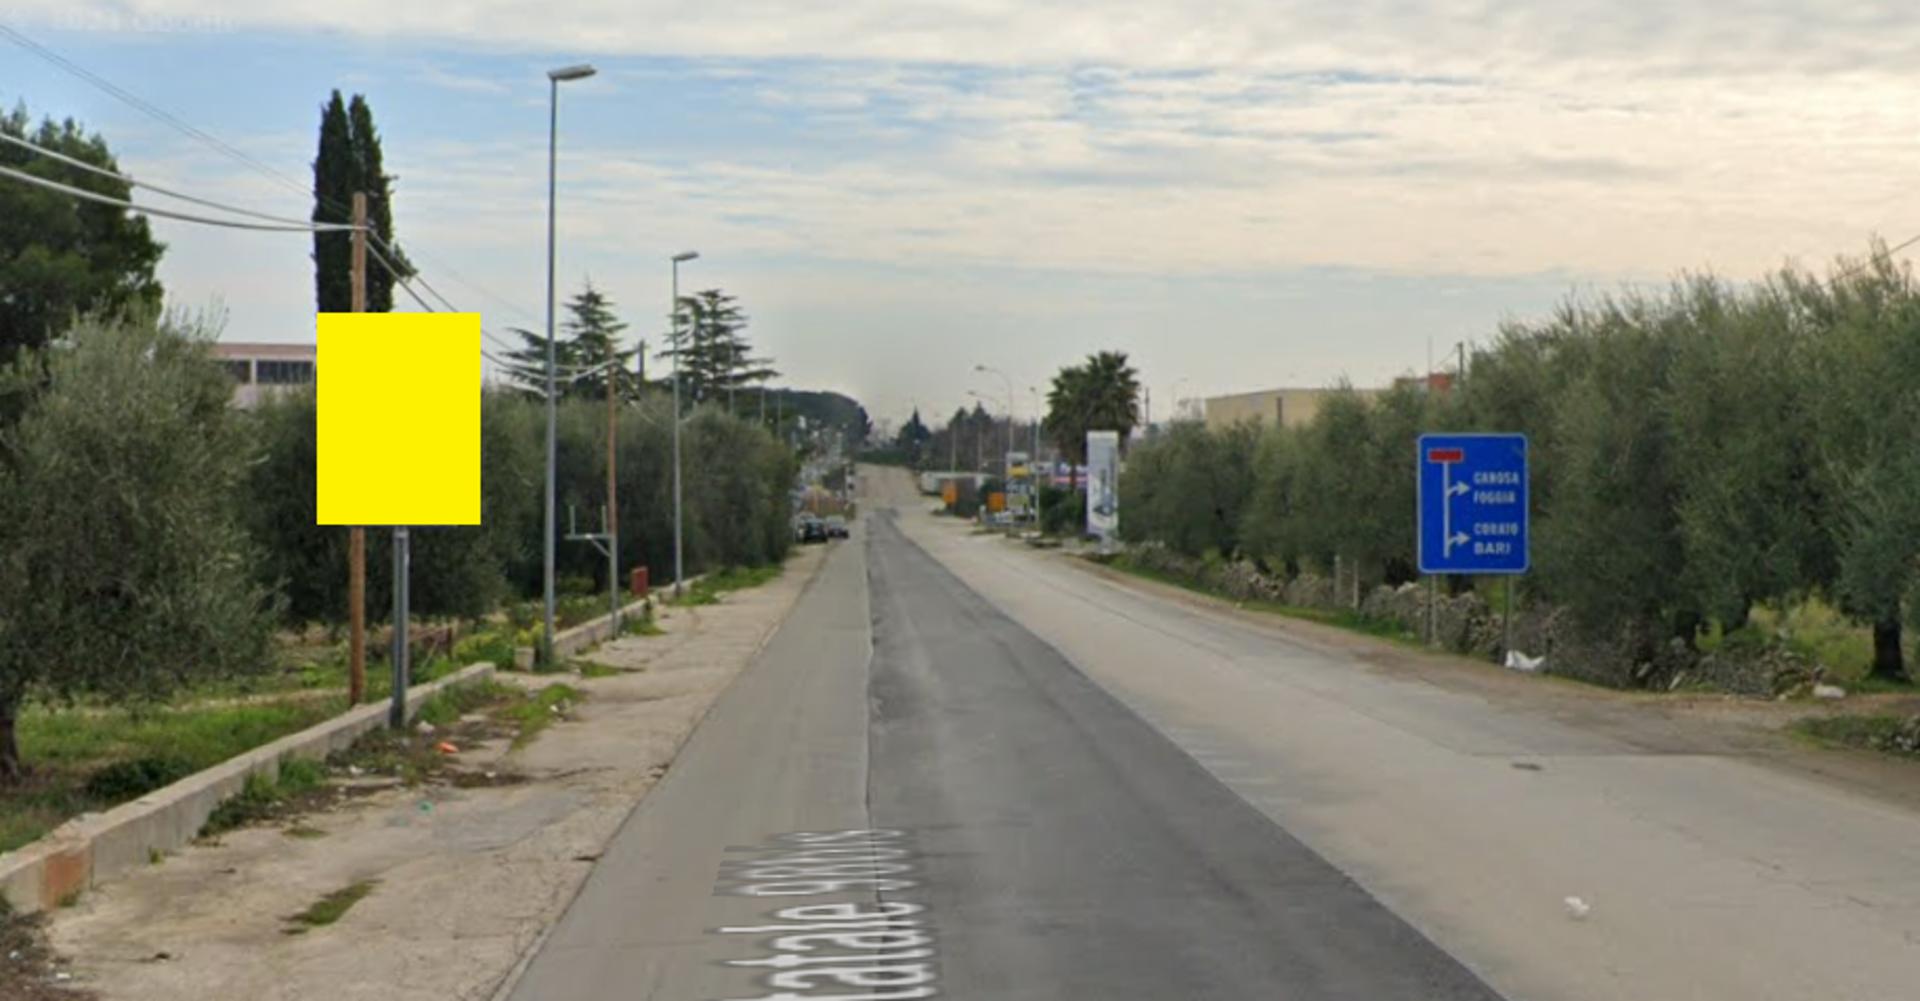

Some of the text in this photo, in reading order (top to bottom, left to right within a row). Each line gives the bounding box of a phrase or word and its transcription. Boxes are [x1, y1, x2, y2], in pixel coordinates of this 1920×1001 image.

[1473, 490, 1516, 504] FOGGIA
[1474, 522, 1519, 535] CORATO
[1474, 542, 1511, 555] BARI
